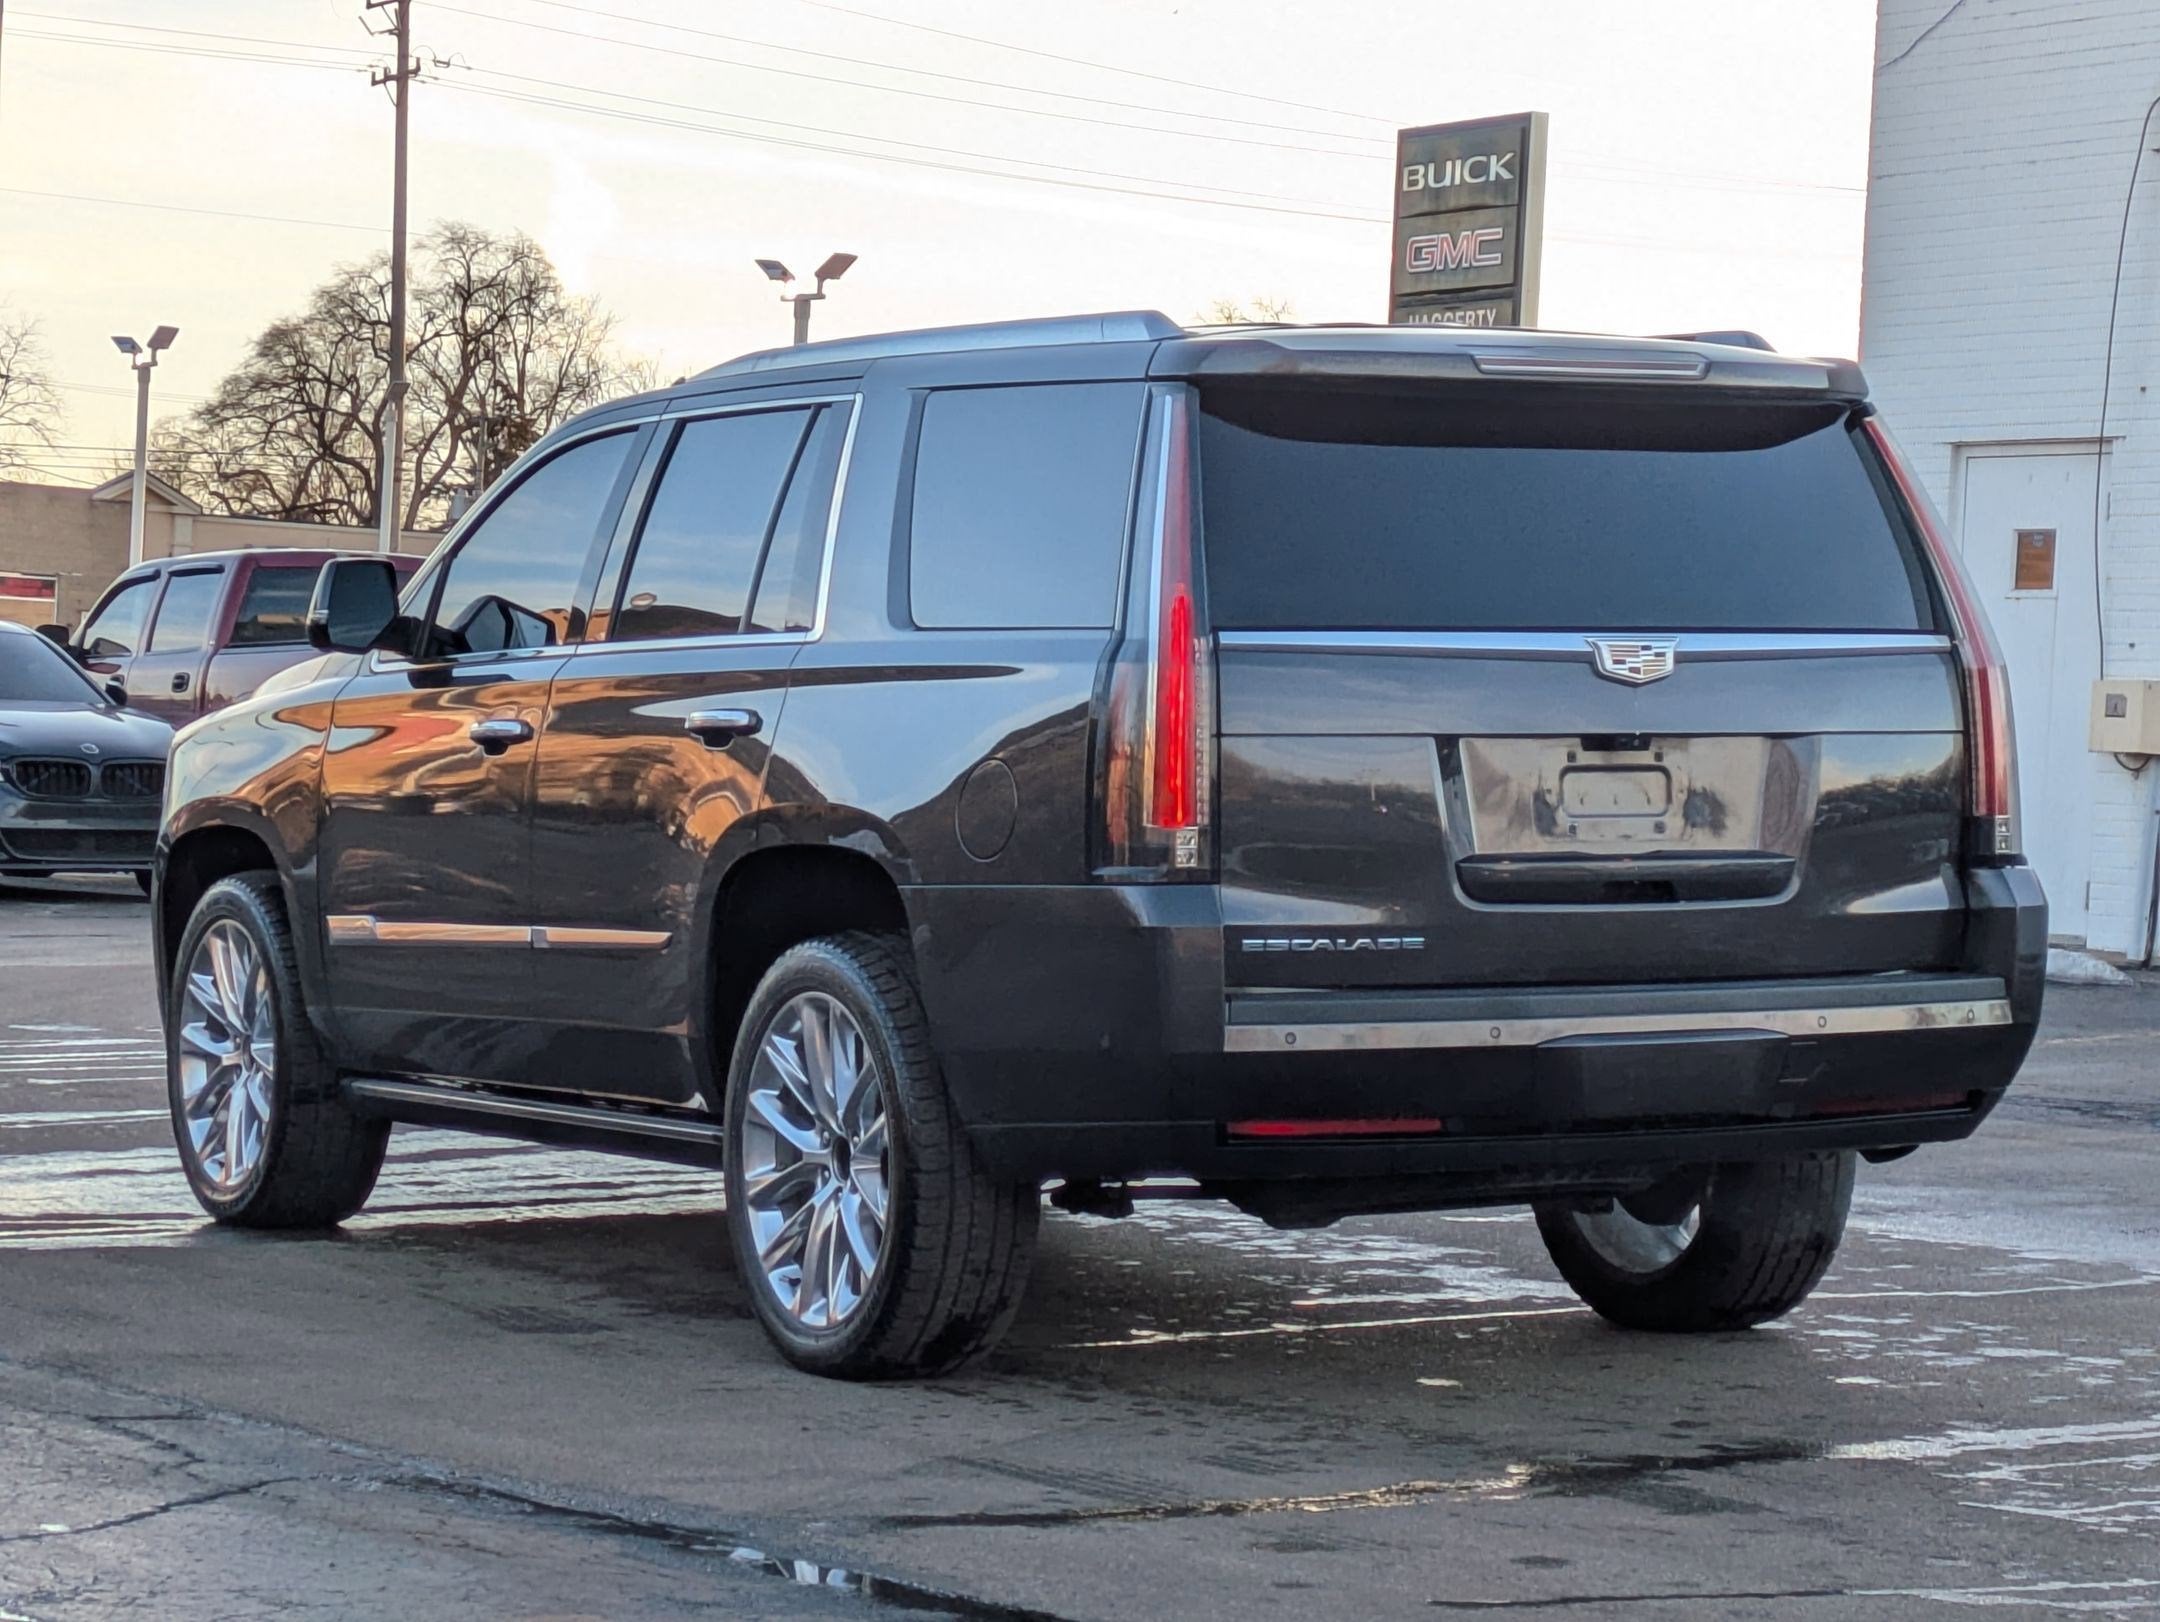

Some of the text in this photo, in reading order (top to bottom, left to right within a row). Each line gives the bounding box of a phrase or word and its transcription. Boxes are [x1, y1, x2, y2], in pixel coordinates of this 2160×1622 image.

[1402, 152, 1515, 192] BUICK
[1406, 227, 1503, 273] GMC
[1242, 937, 1425, 951] ESCALADE
